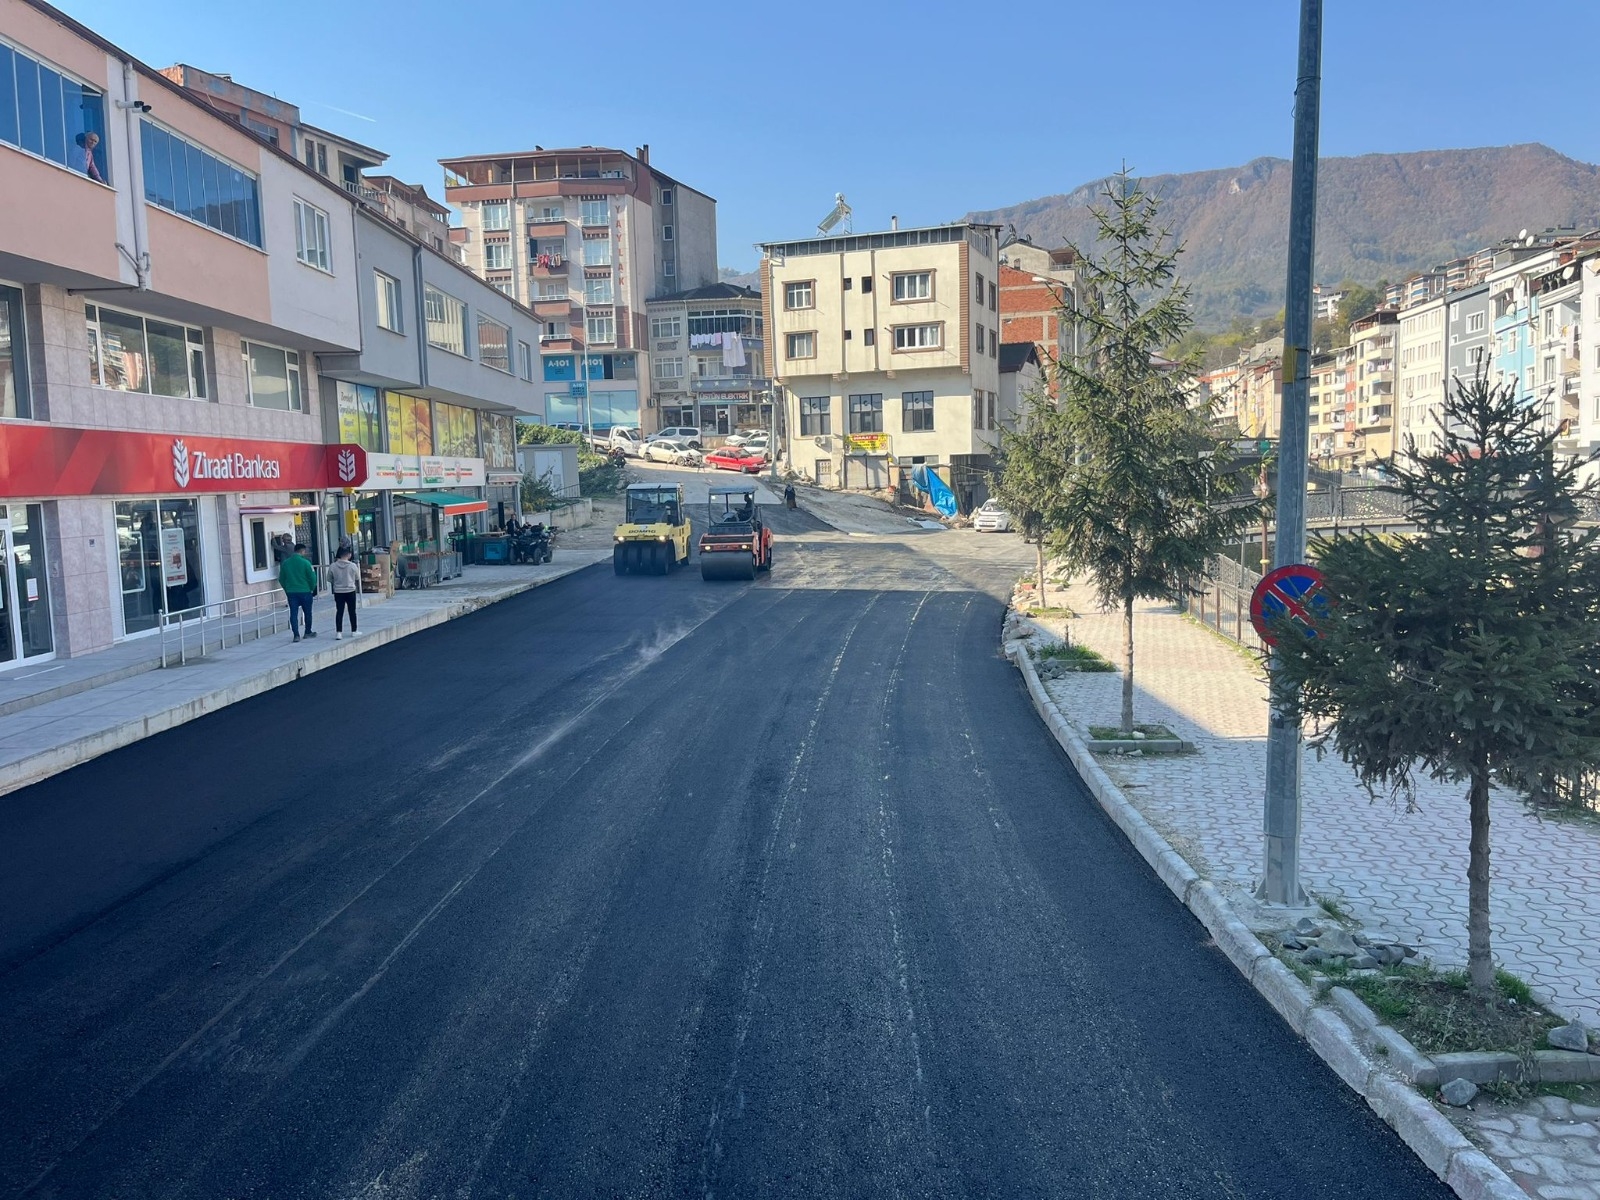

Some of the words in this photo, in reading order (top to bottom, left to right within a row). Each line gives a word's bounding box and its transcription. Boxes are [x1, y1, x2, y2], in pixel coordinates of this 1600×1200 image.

[615, 205, 625, 285] YAYLAK
[699, 391, 720, 400] ÜSTÜN
[192, 451, 234, 479] Ziraat
[234, 452, 280, 479] Bankası
